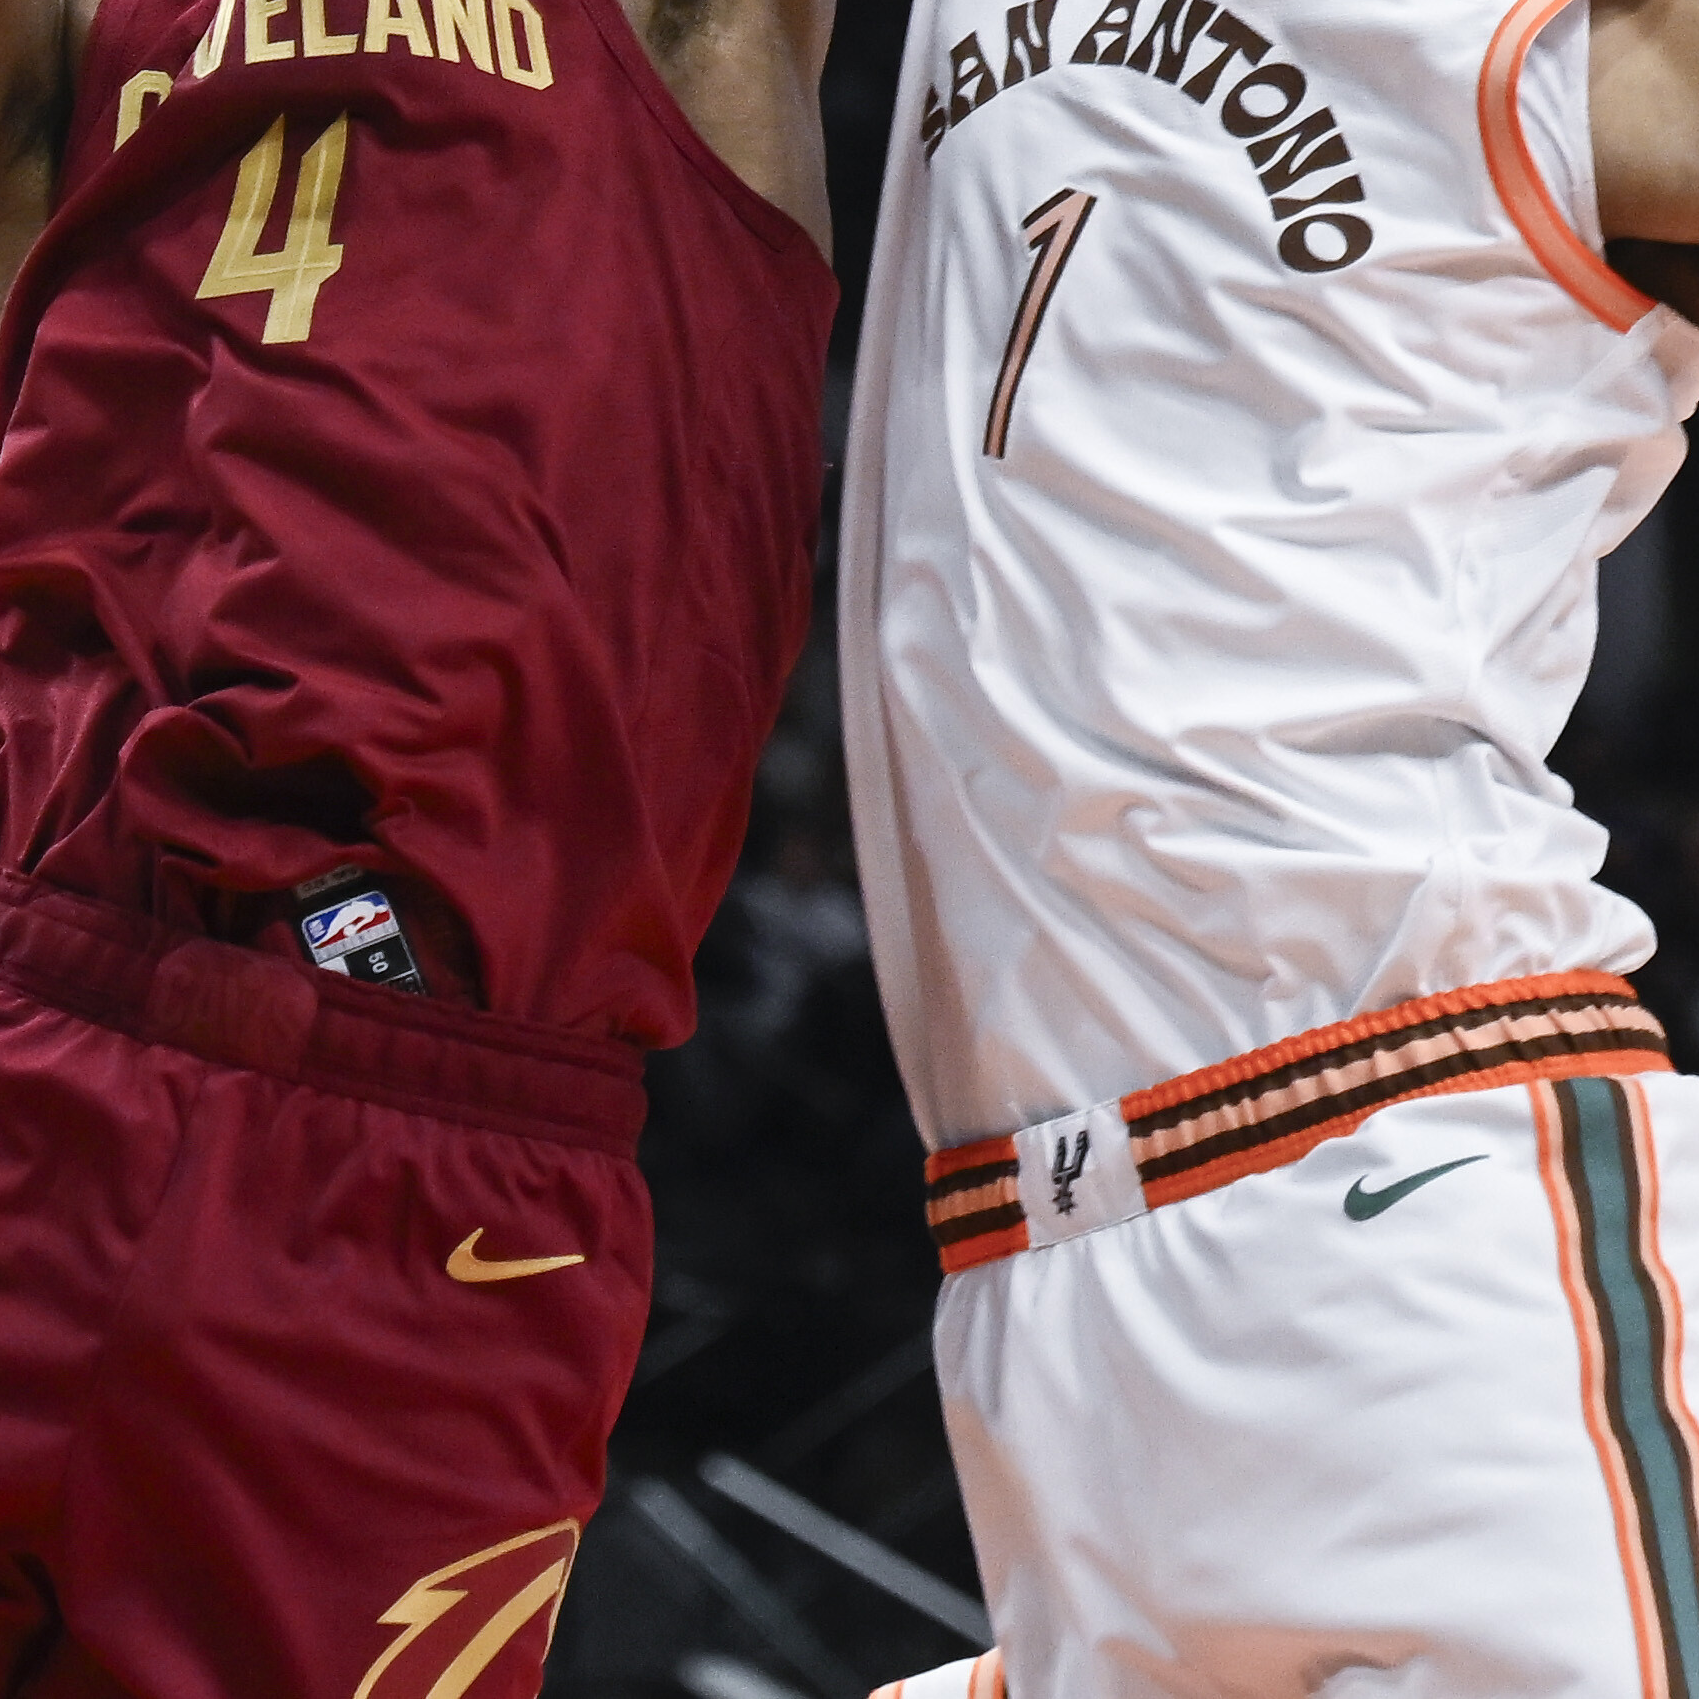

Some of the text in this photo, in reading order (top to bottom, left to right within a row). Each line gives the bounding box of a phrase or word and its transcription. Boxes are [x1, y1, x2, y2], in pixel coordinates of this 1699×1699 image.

[194, 109, 349, 345] 4
[982, 186, 1098, 460] 1
[367, 950, 390, 975] 50
